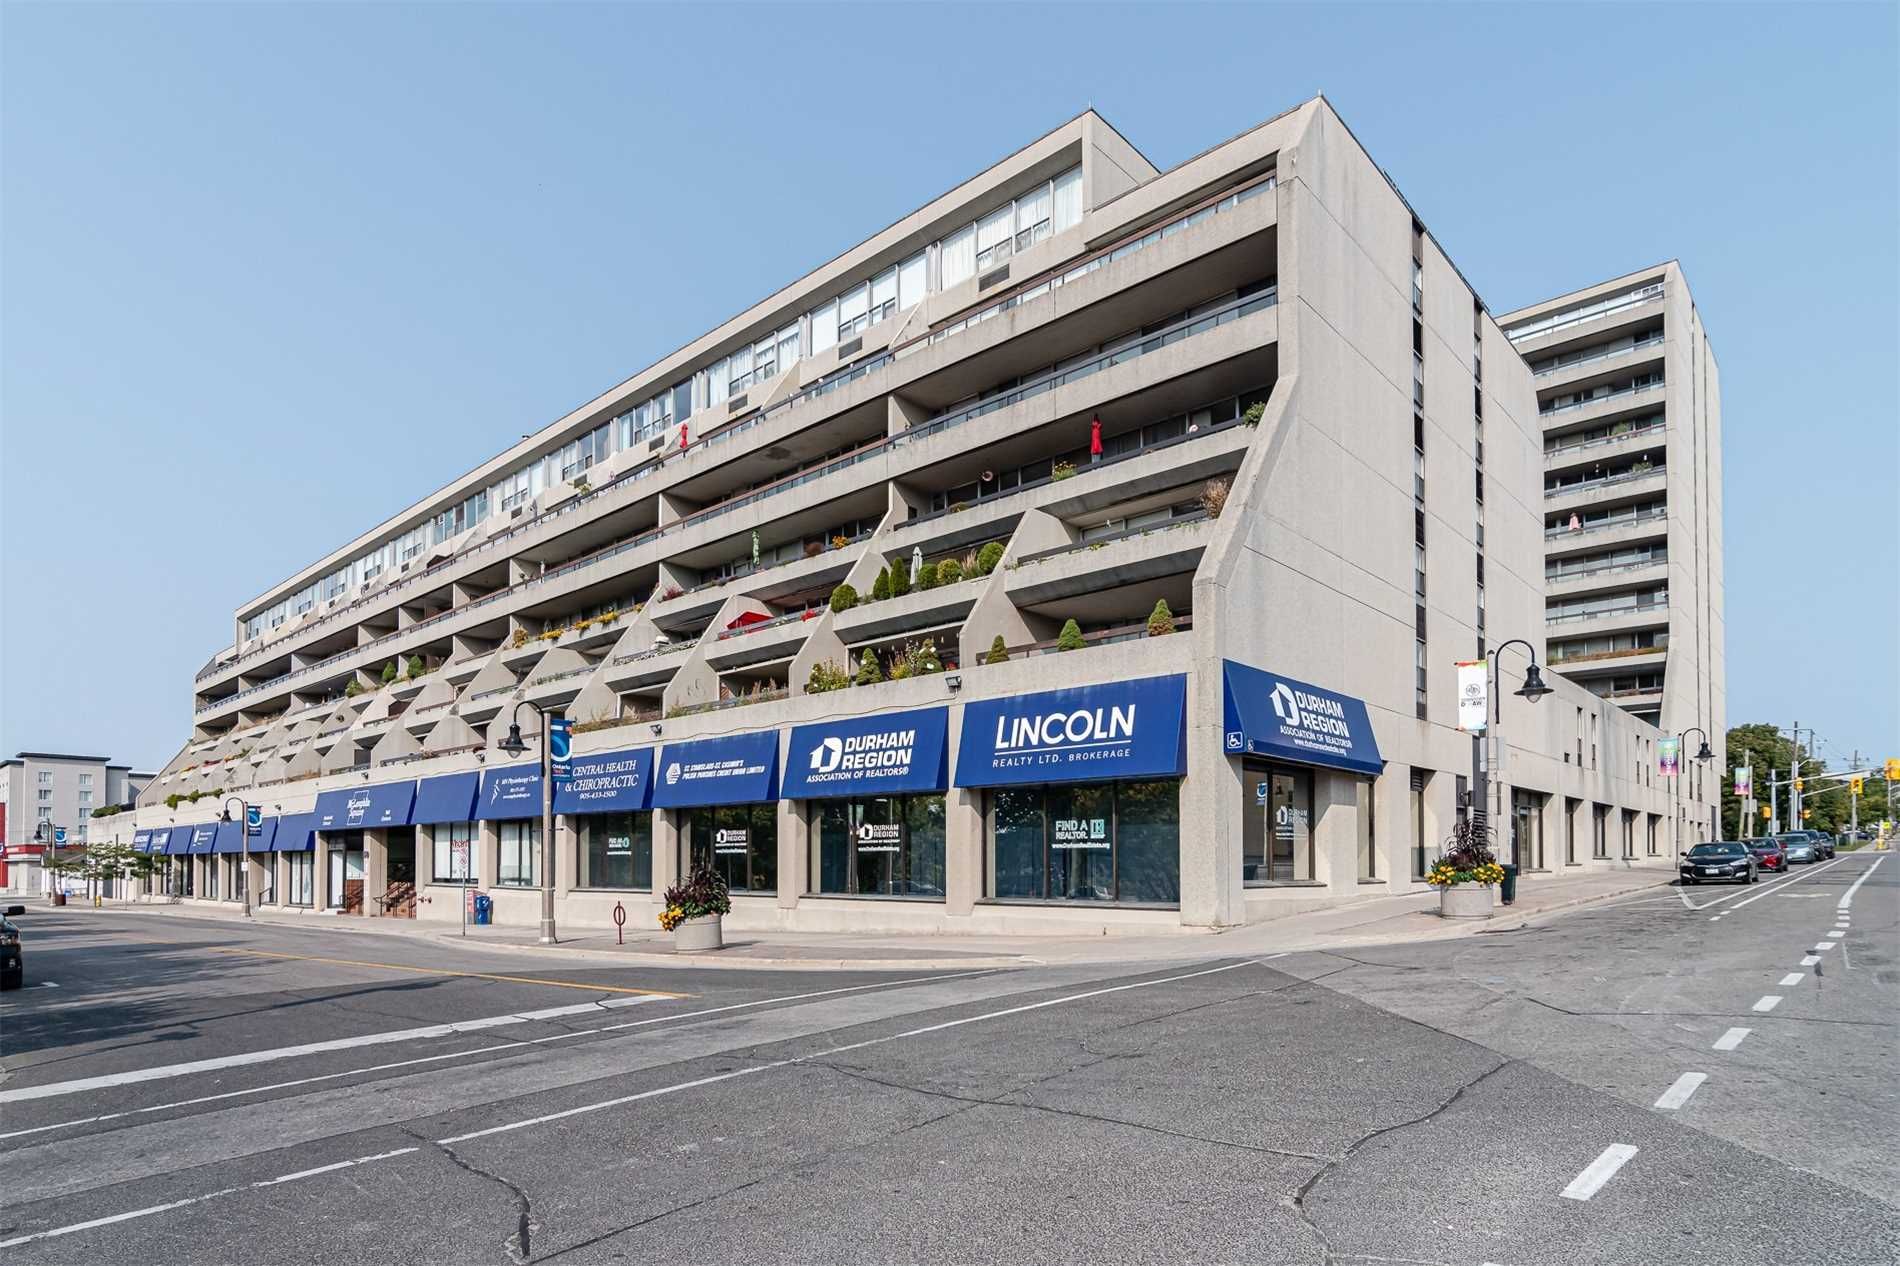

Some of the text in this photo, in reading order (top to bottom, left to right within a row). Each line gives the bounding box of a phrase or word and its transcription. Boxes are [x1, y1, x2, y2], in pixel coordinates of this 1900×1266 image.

[1294, 690, 1345, 719] DURHAM
[995, 704, 1136, 749] LINCOLN
[1300, 710, 1350, 738] REGION
[844, 730, 916, 752] DURHAM
[1280, 725, 1316, 741] ASSOCIATION
[1316, 733, 1324, 742] OF
[841, 748, 913, 770] REGION
[992, 748, 1131, 768] REALTY LTD. BROKERAGE
[572, 760, 637, 777] CENTRAL HEALTH
[806, 771, 852, 783] ASSOCIATION
[853, 770, 864, 779] OF
[564, 774, 639, 792] & CHIROPRACTIC
[579, 790, 617, 800] 905-433-1500
[873, 830, 899, 838] REGION
[1055, 820, 1088, 831] FIND A
